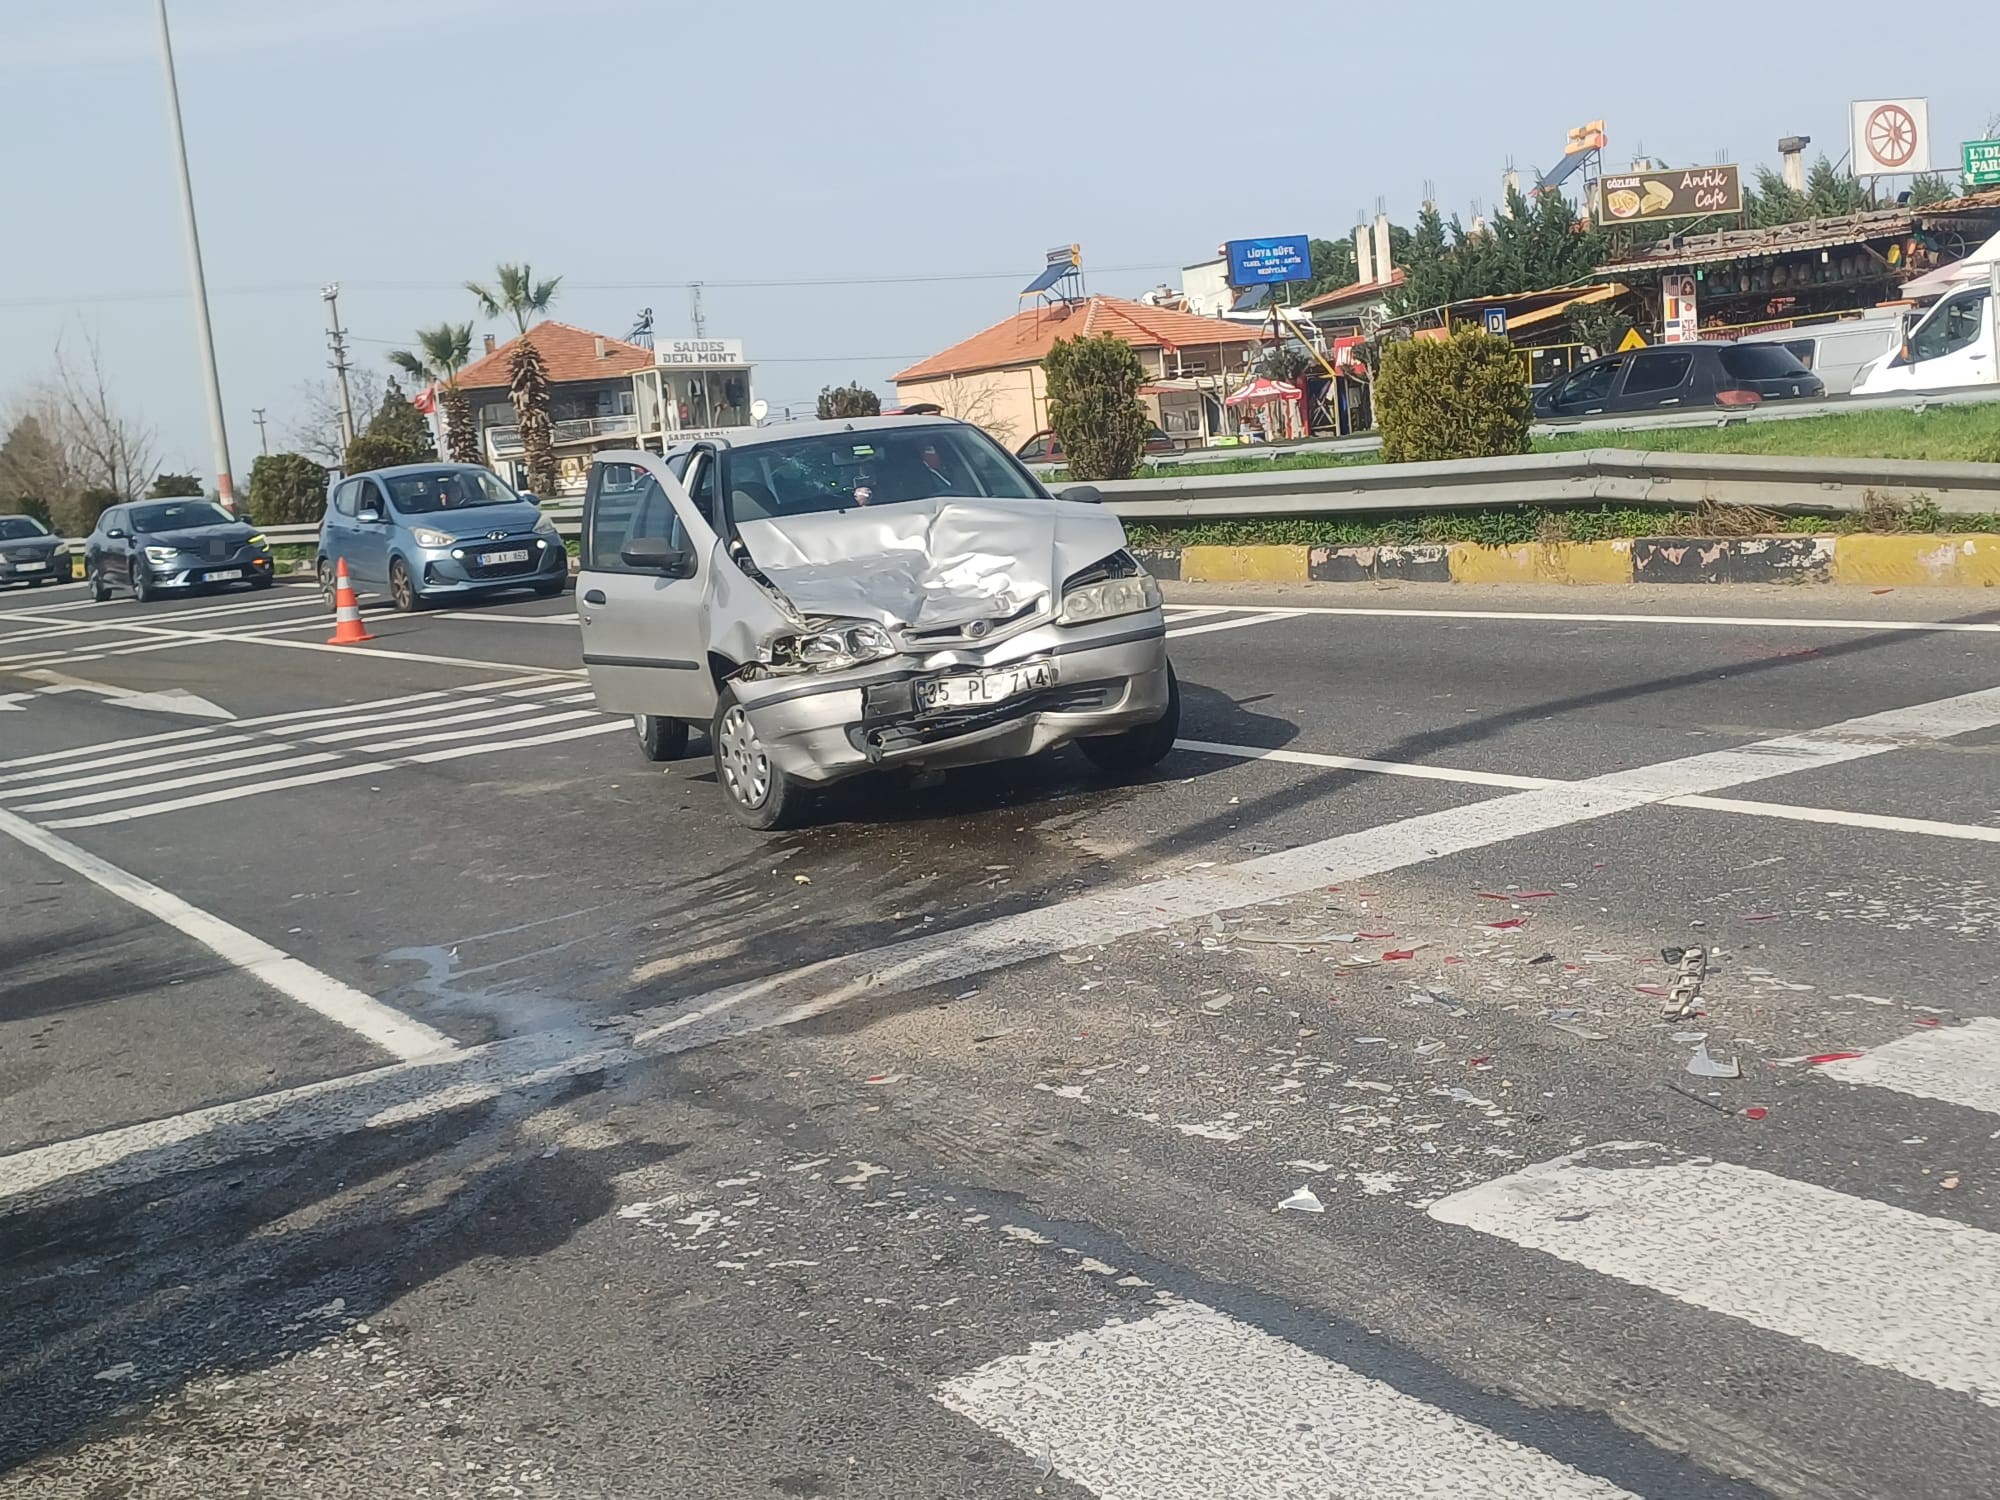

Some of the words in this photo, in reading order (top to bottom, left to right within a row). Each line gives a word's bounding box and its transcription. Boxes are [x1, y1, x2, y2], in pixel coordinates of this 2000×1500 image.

[1970, 160, 2000, 173] PAR
[1680, 169, 1728, 190] Antik
[1695, 188, 1728, 211] Cafe
[1491, 316, 1500, 330] D
[673, 342, 725, 352] SARDES
[697, 352, 736, 363] MONT
[927, 682, 949, 704] 35
[968, 678, 992, 701] PL
[1010, 668, 1047, 693] 714
